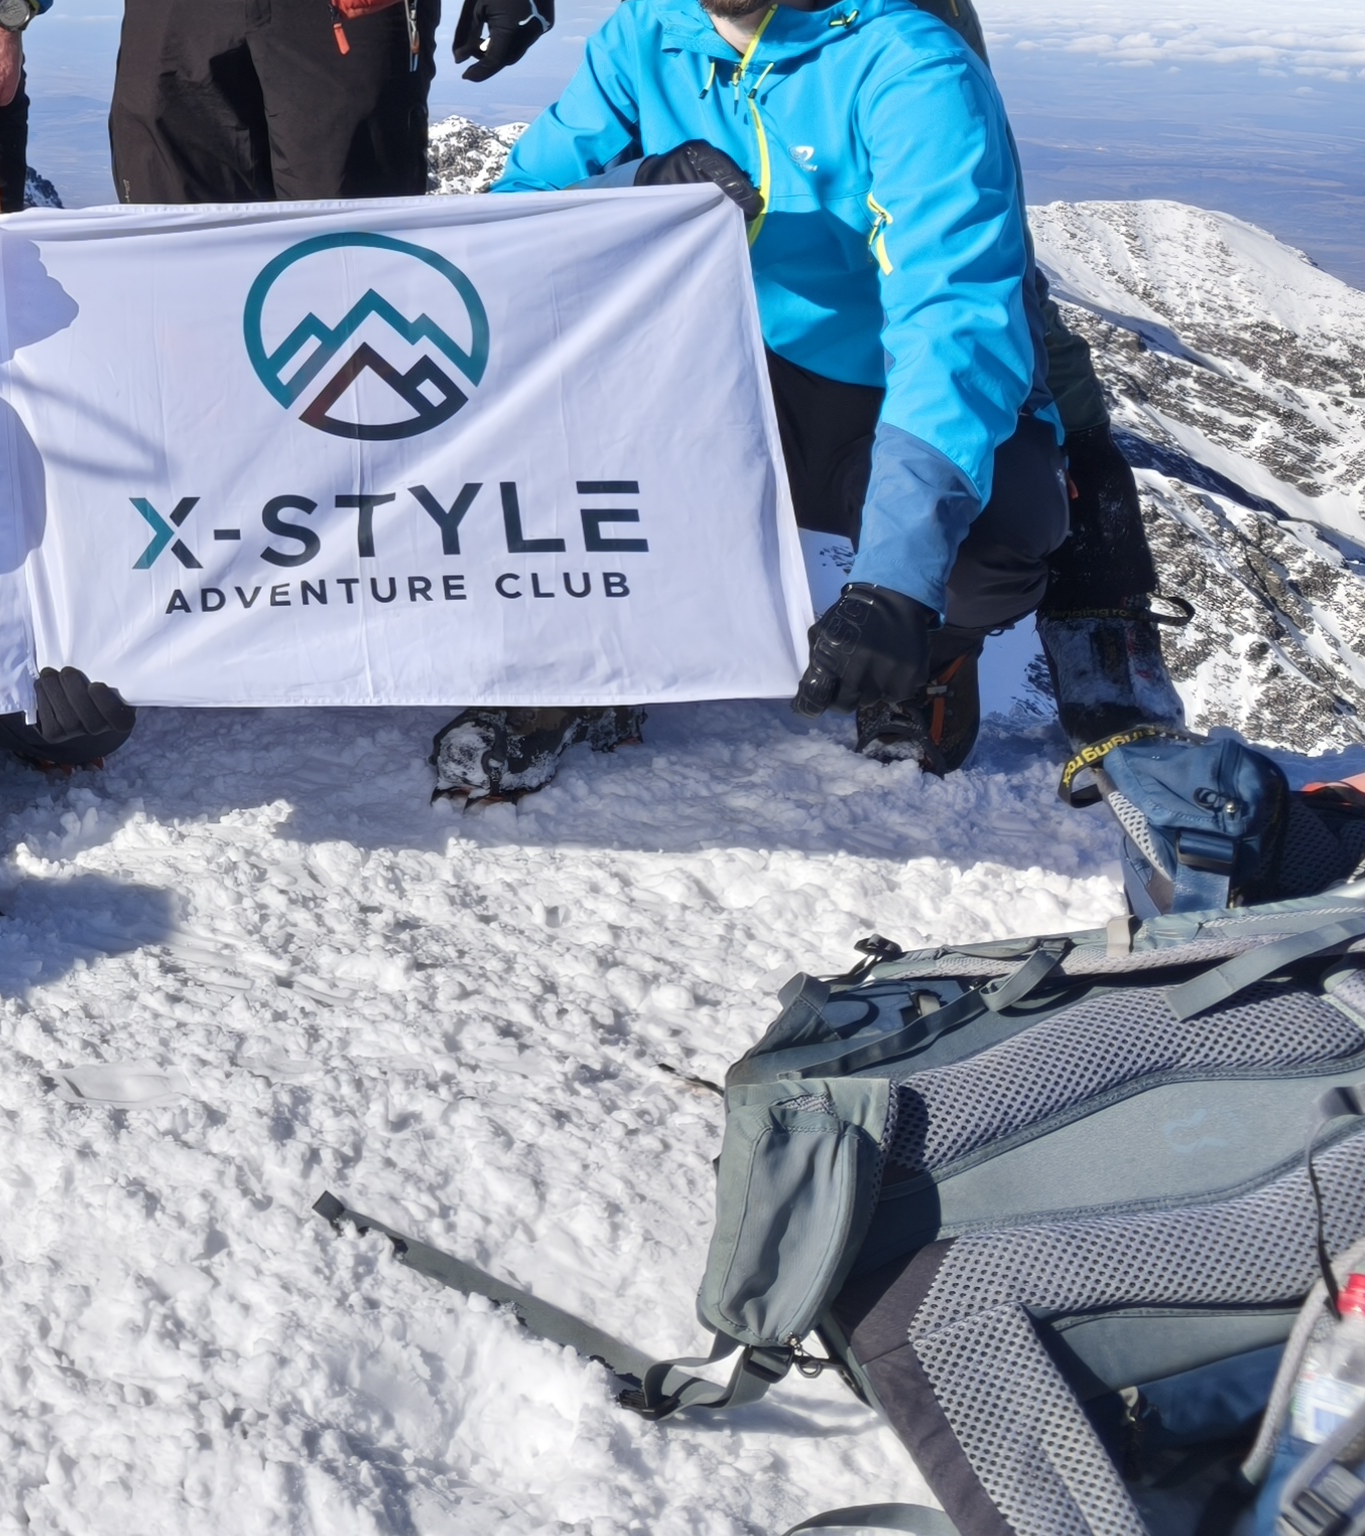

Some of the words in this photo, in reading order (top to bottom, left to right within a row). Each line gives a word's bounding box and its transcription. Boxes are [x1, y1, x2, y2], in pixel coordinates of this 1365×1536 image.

[128, 480, 650, 571] X-STYLE
[164, 574, 469, 616] ADVENTURE
[494, 571, 632, 600] CLUB
